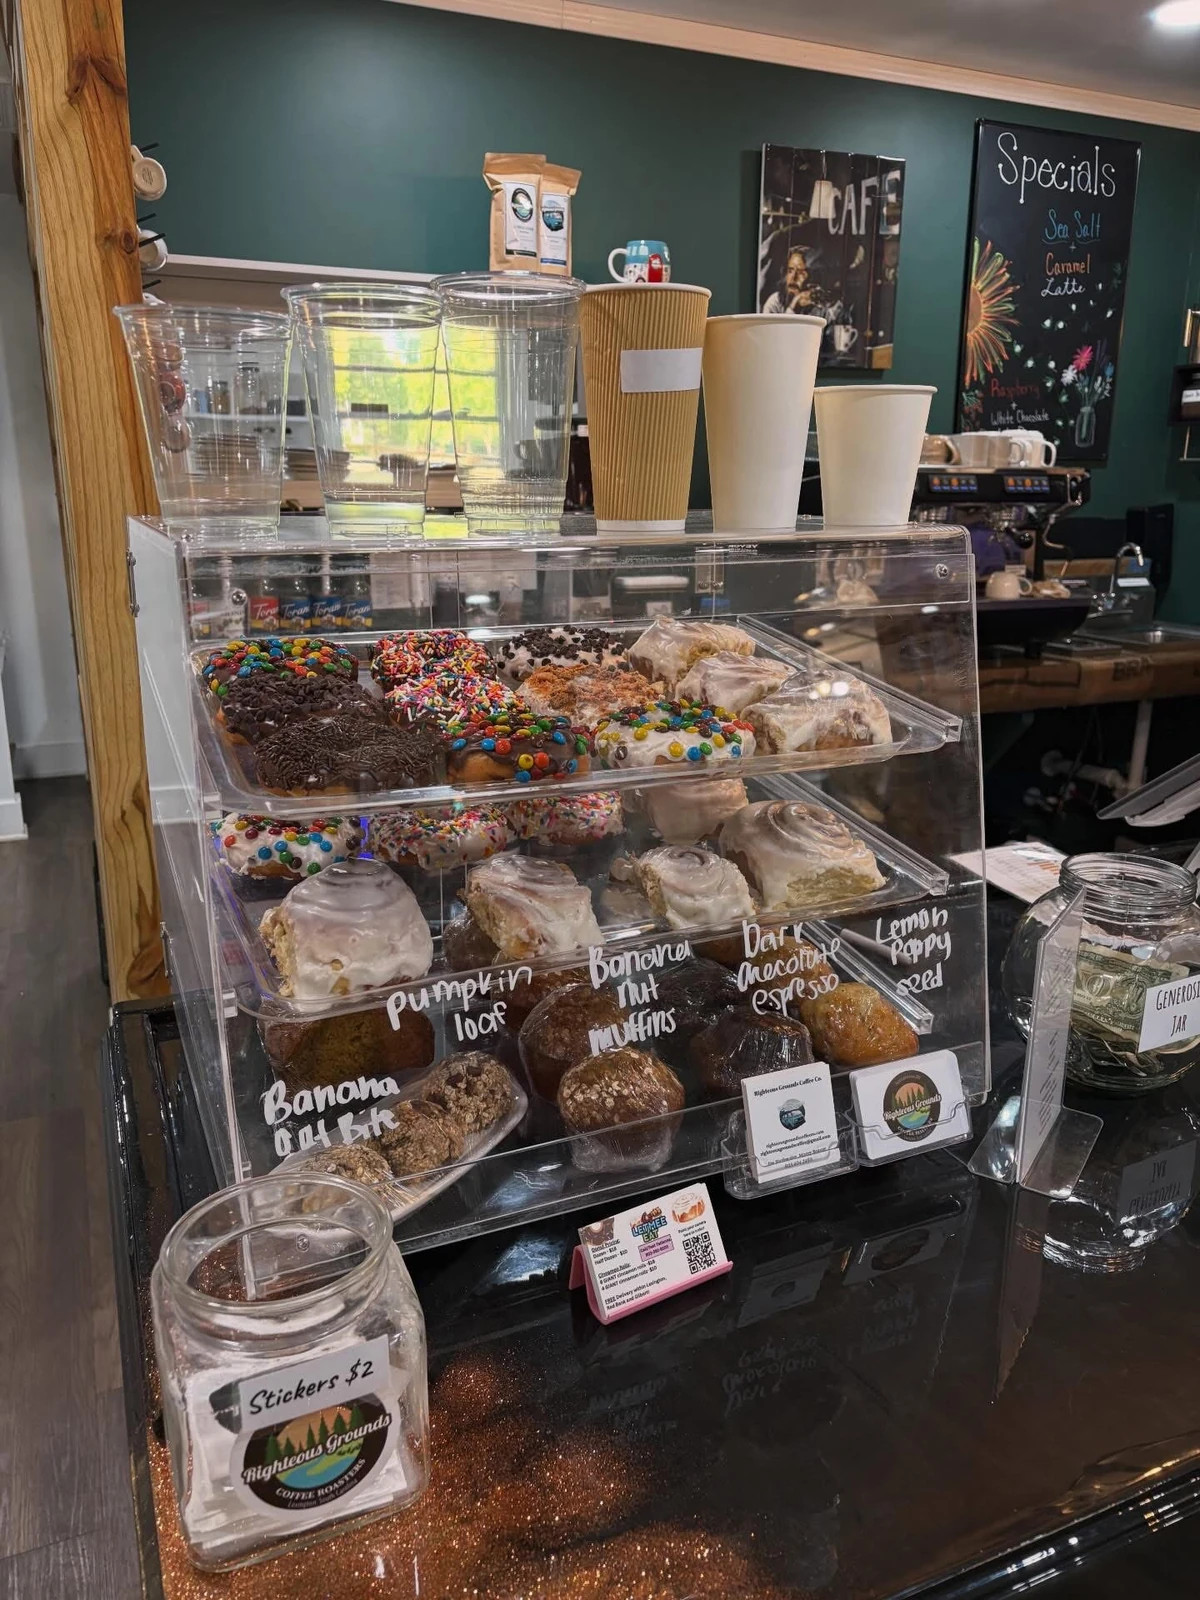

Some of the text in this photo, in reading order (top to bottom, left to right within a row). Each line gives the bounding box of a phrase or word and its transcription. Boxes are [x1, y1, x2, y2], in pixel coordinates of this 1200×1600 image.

[997, 132, 1116, 204] Specials
[1045, 209, 1100, 241] Sea Salt
[1046, 252, 1091, 275] Caramel
[1041, 277, 1086, 297] Latte
[991, 408, 1049, 425] White Chocolate
[875, 907, 948, 943] Lemon
[588, 940, 690, 989] Banana
[895, 962, 945, 997] seed
[752, 973, 840, 1017] espresso
[454, 1001, 508, 1042] loaf
[1170, 1015, 1188, 1037] JAR
[263, 1075, 400, 1126] Banana
[883, 1094, 942, 1120] Righteous Grounds
[642, 1229, 659, 1243] EAT
[603, 1274, 616, 1283] GIANT
[605, 1281, 618, 1290] GIANT
[616, 1290, 633, 1299] Delivery
[615, 1300, 626, 1308] Bank
[249, 1358, 374, 1415] Stickers $2
[243, 1413, 392, 1484] Righteous Grounds
[276, 1457, 366, 1500] COFFEE ROASTERS
